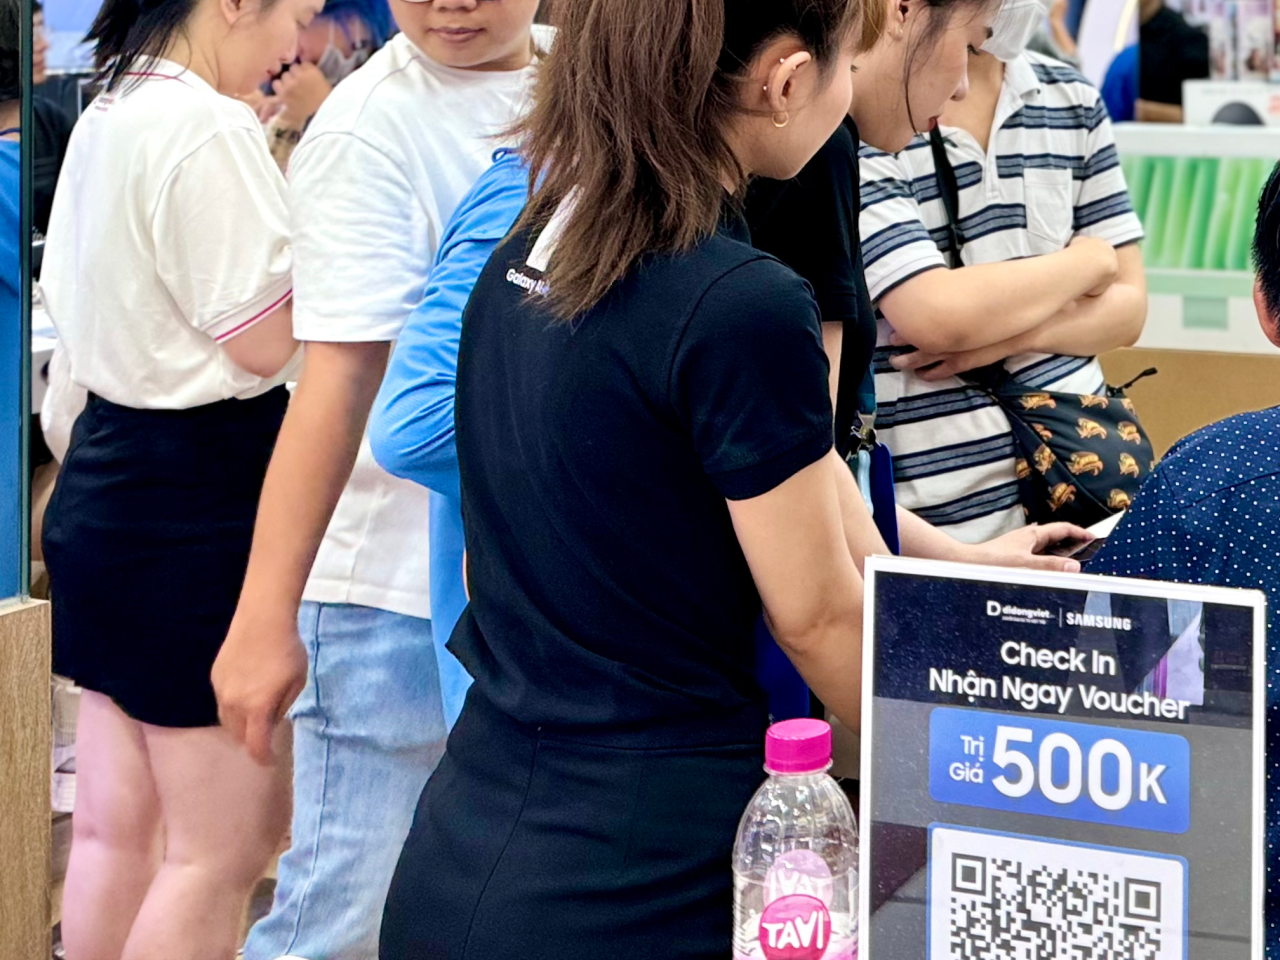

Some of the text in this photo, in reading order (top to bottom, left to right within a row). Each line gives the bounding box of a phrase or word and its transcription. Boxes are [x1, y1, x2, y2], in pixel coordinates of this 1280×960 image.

[505, 268, 537, 295] Galaxy
[1065, 612, 1132, 631] SAMSUNG
[1000, 640, 1116, 677] Check In
[929, 667, 1191, 721] Nhận Ngay Voucher
[960, 734, 985, 762] Trị
[949, 761, 984, 784] Giá
[761, 910, 824, 950] TAVI
